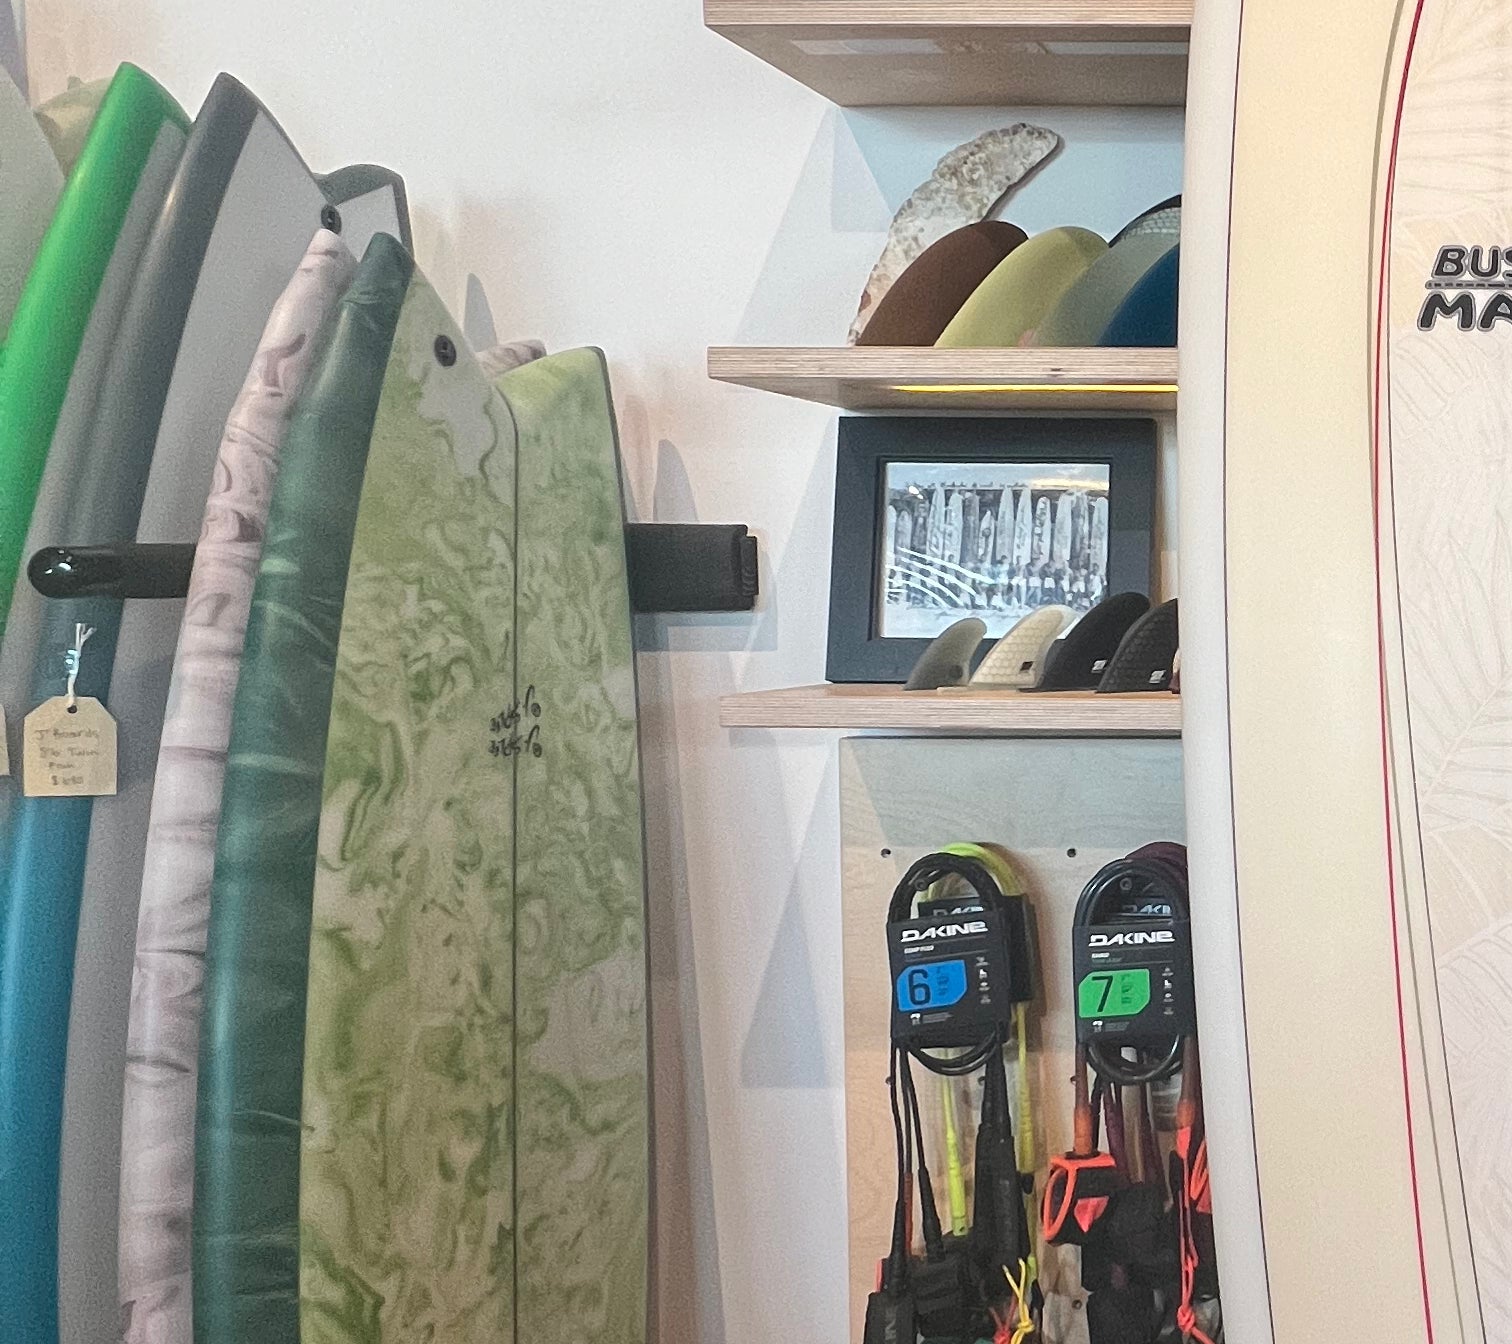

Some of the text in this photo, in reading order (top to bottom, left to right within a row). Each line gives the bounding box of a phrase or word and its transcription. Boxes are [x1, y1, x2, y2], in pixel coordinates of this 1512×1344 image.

[901, 921, 988, 943] DAKINE
[1088, 930, 1176, 948] DAKINE
[908, 968, 932, 1006] 6
[1091, 975, 1114, 1013] 7
